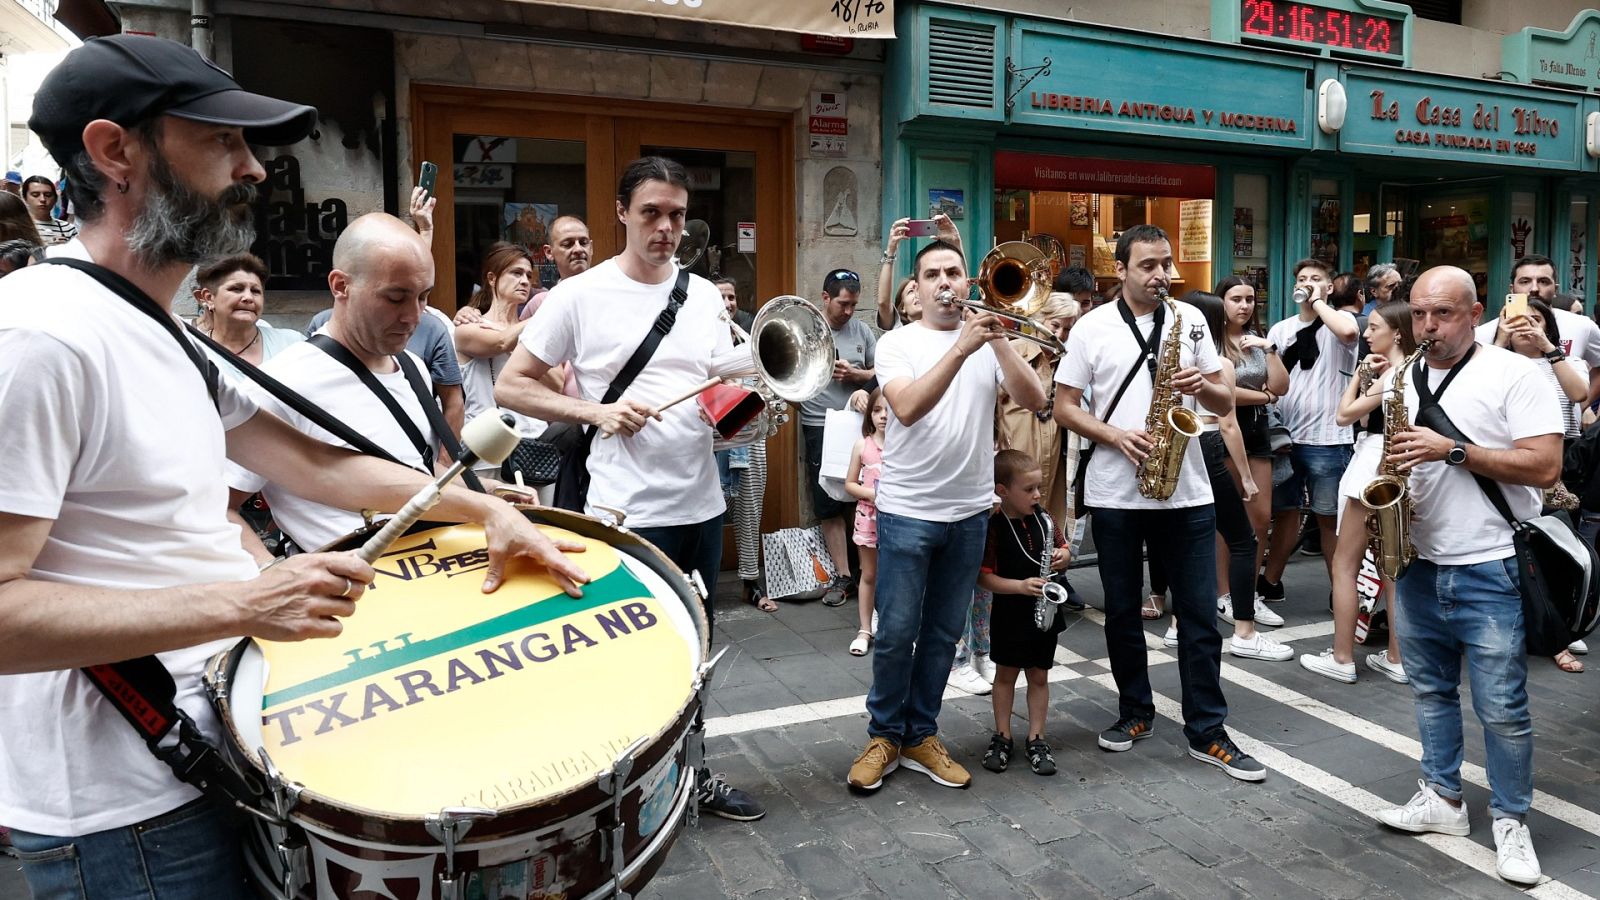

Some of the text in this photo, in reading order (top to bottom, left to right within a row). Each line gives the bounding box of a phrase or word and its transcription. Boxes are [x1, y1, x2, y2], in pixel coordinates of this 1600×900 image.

[1245, 0, 1391, 53] 29:16:51:23
[811, 118, 846, 129] Alarma
[1031, 91, 1297, 133] LIBRERIA ANTIGUA Y MODERNA
[1369, 89, 1559, 138] La Casa del Libro
[1395, 129, 1431, 146] CASA
[1435, 133, 1492, 151] FUNDADA
[1496, 139, 1510, 153] EN
[1068, 172, 1078, 180] en
[1079, 170, 1182, 187] www.lalibreriadelaestafeta.com
[262, 602, 659, 748] TXARANGA NB
